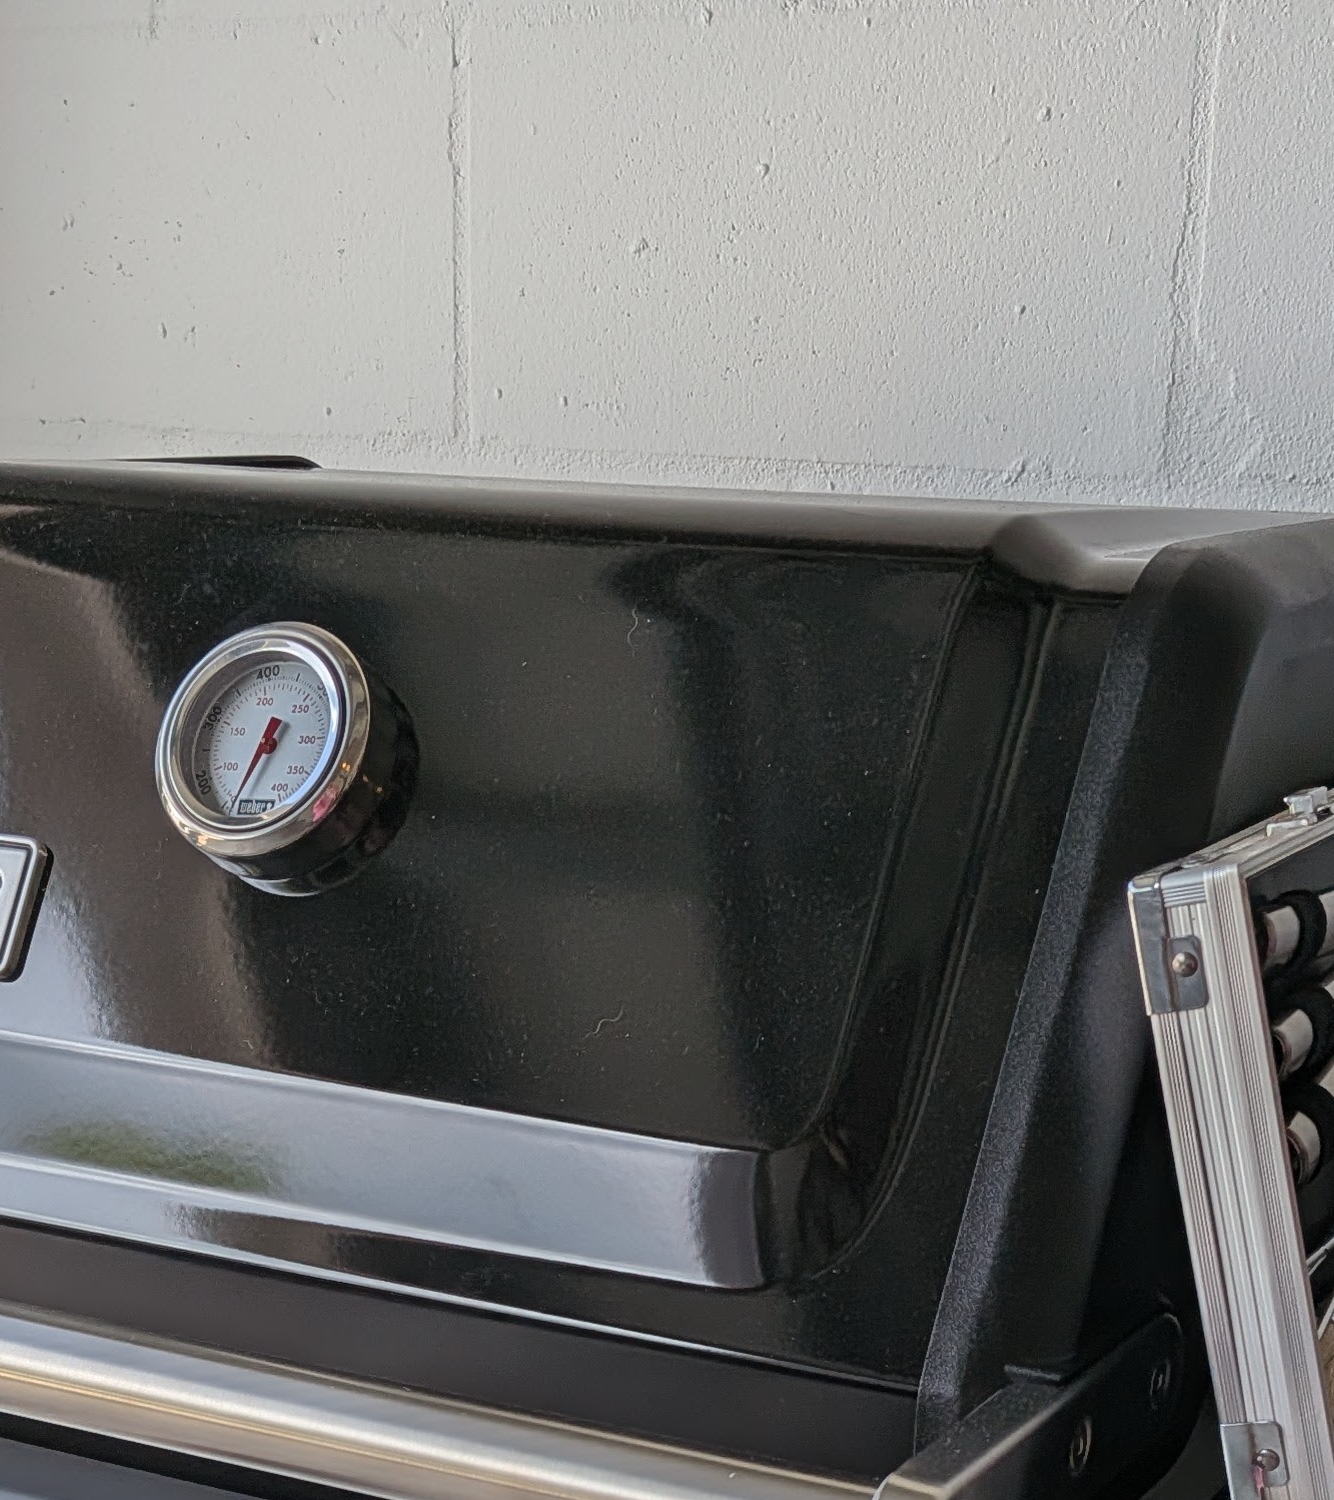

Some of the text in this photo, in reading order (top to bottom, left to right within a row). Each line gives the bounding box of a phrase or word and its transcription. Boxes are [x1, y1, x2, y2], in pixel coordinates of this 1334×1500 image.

[256, 664, 280, 680] 400
[256, 697, 274, 706] 200
[291, 704, 309, 713] 250
[230, 727, 246, 736] 150
[298, 735, 316, 744] 300
[223, 762, 239, 771] 100
[287, 766, 305, 775] 350
[195, 769, 212, 795] 200
[270, 783, 288, 792] 400
